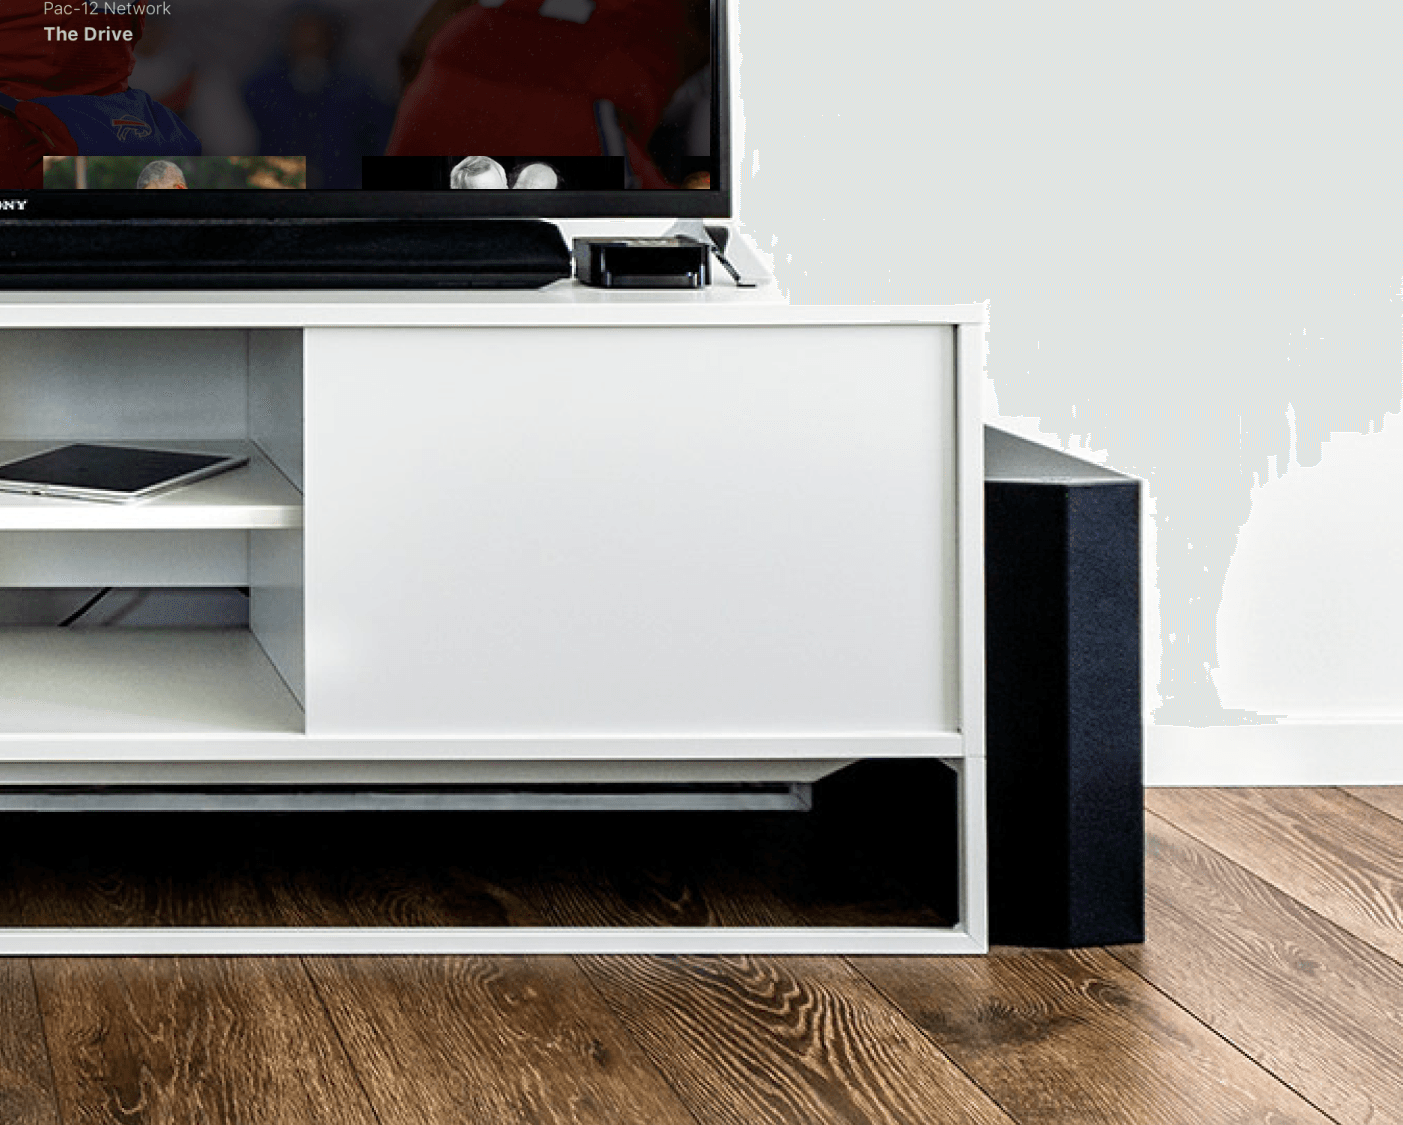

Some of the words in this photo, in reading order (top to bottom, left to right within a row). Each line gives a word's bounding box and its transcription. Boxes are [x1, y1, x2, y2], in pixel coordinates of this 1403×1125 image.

[44, 1, 99, 15] Pac-12
[104, 1, 171, 15] Network
[44, 27, 79, 42] The
[84, 27, 133, 42] Drive
